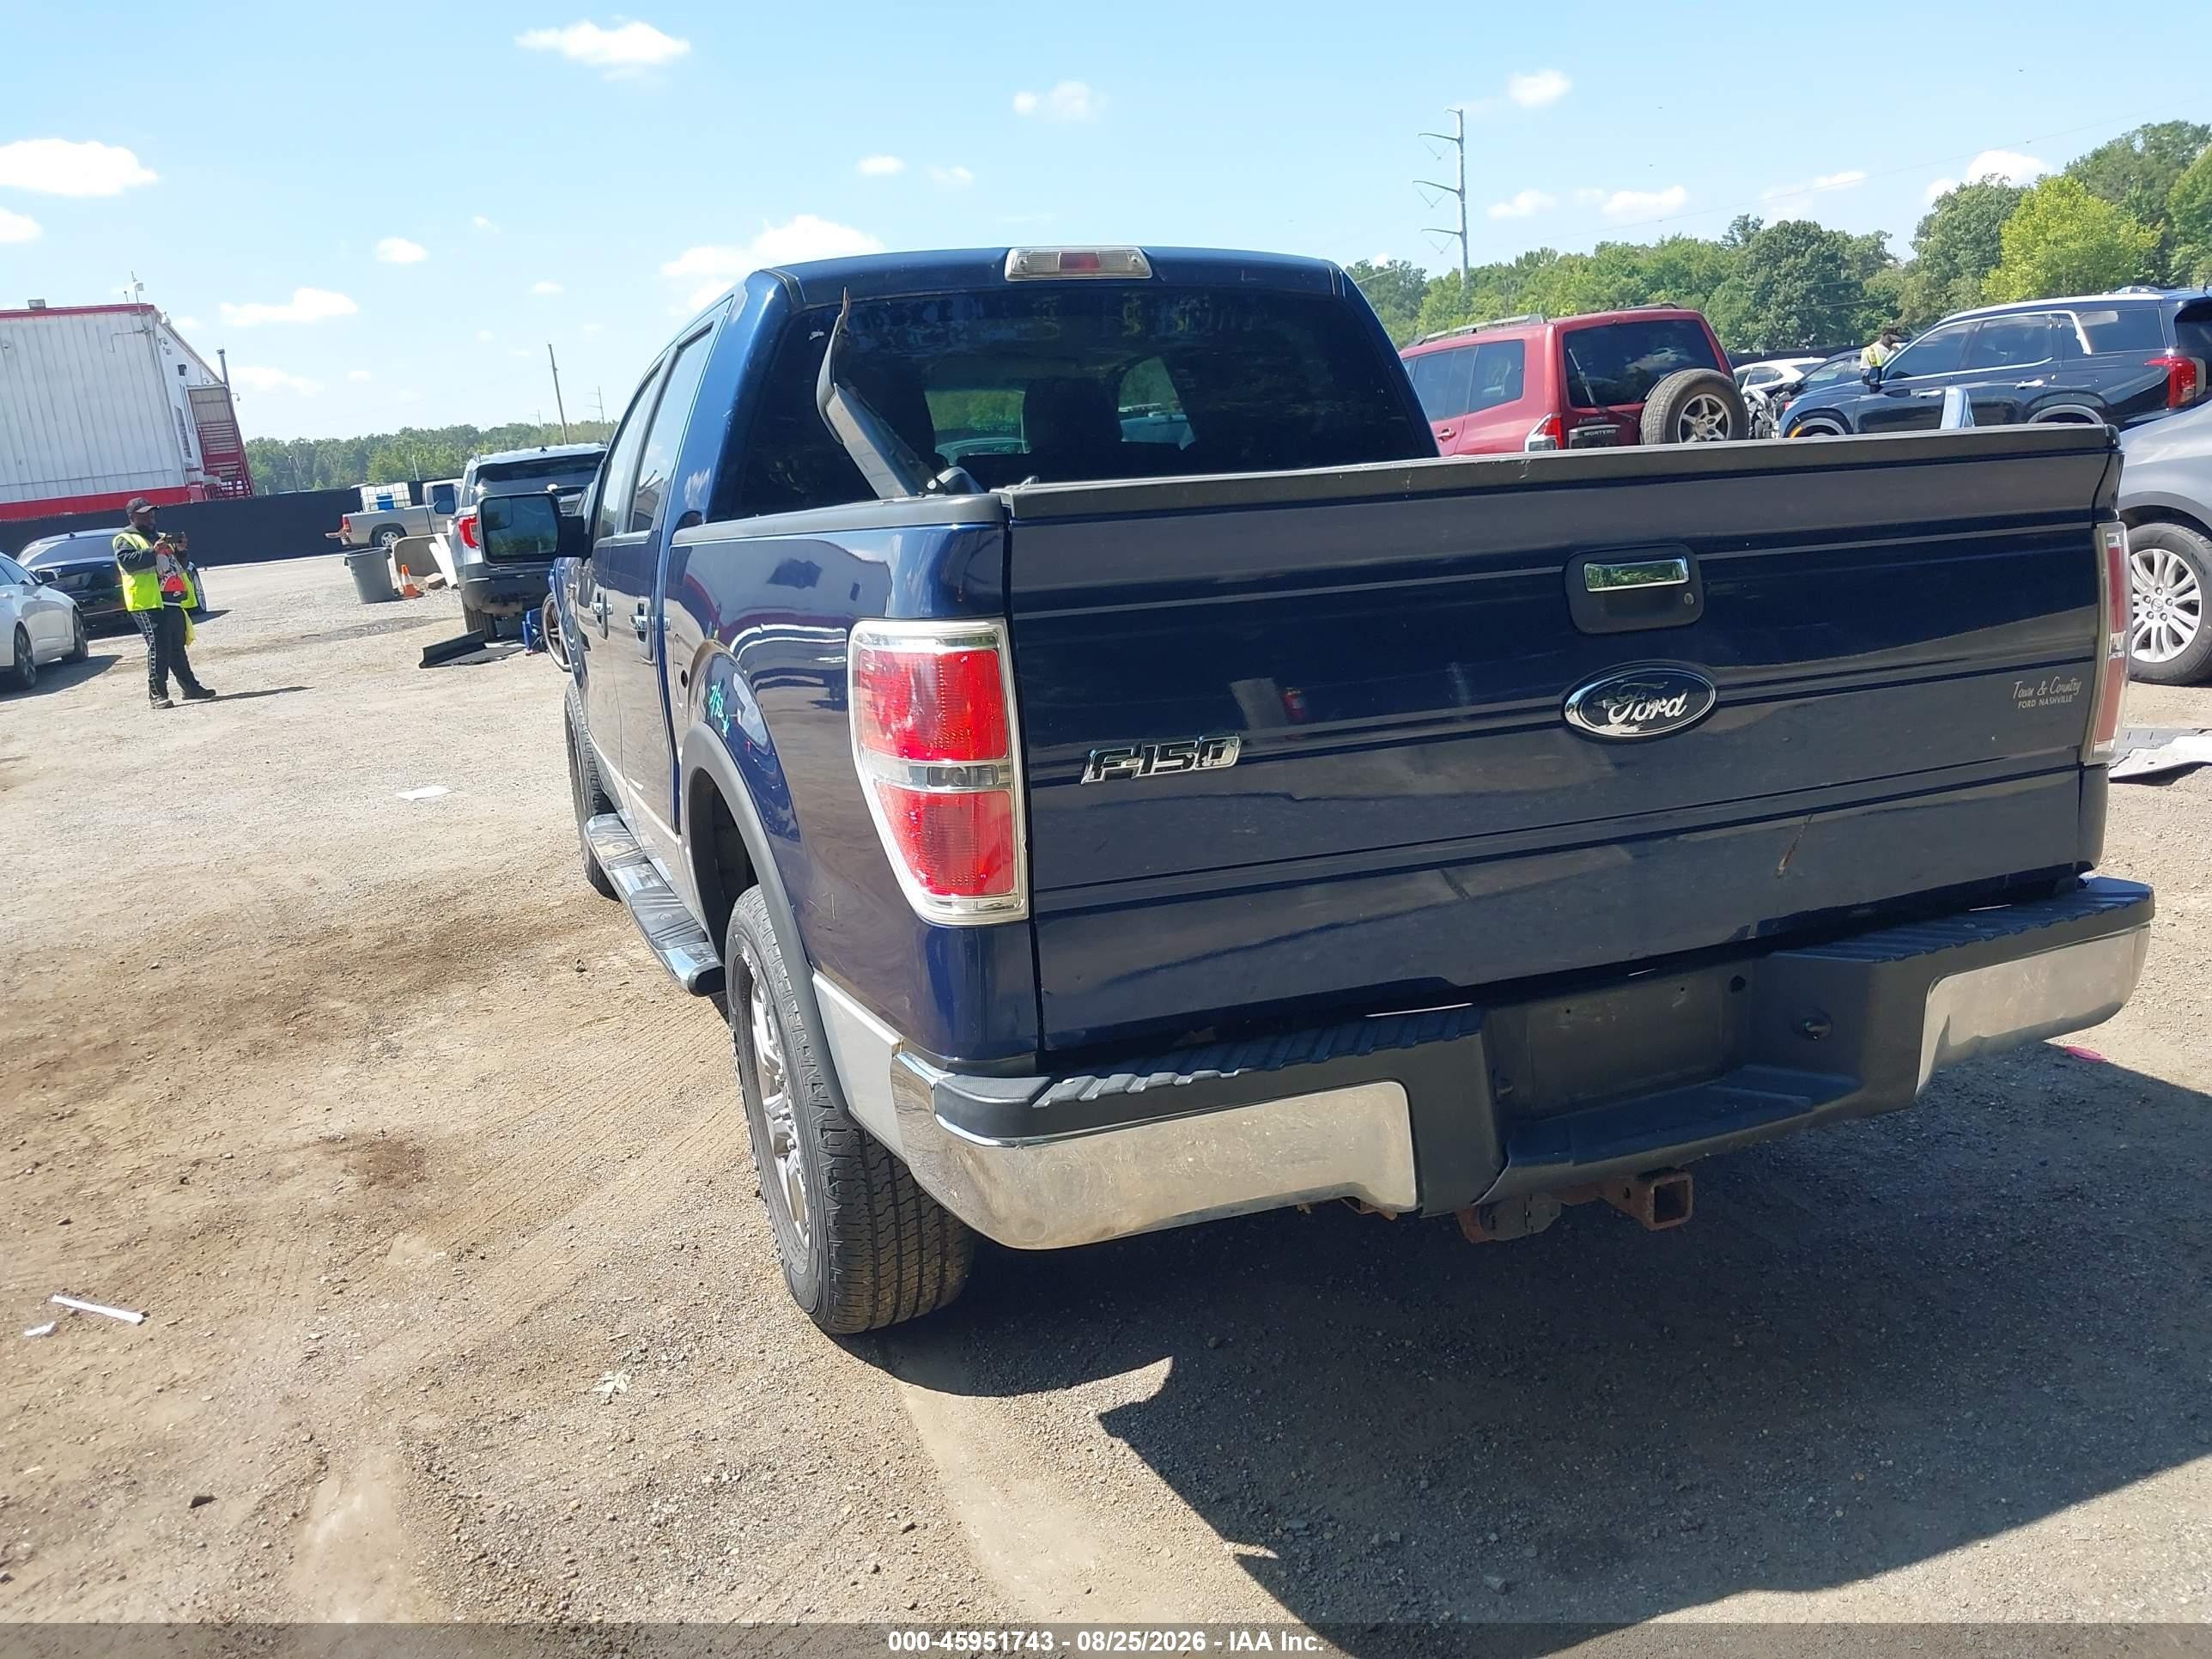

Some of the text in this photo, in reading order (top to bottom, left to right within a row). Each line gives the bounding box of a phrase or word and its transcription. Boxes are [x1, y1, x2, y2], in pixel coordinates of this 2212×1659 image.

[2013, 676, 2082, 700] Town & Country
[1594, 679, 1688, 724] Ford
[2018, 694, 2073, 708] FORD NASHVILLE
